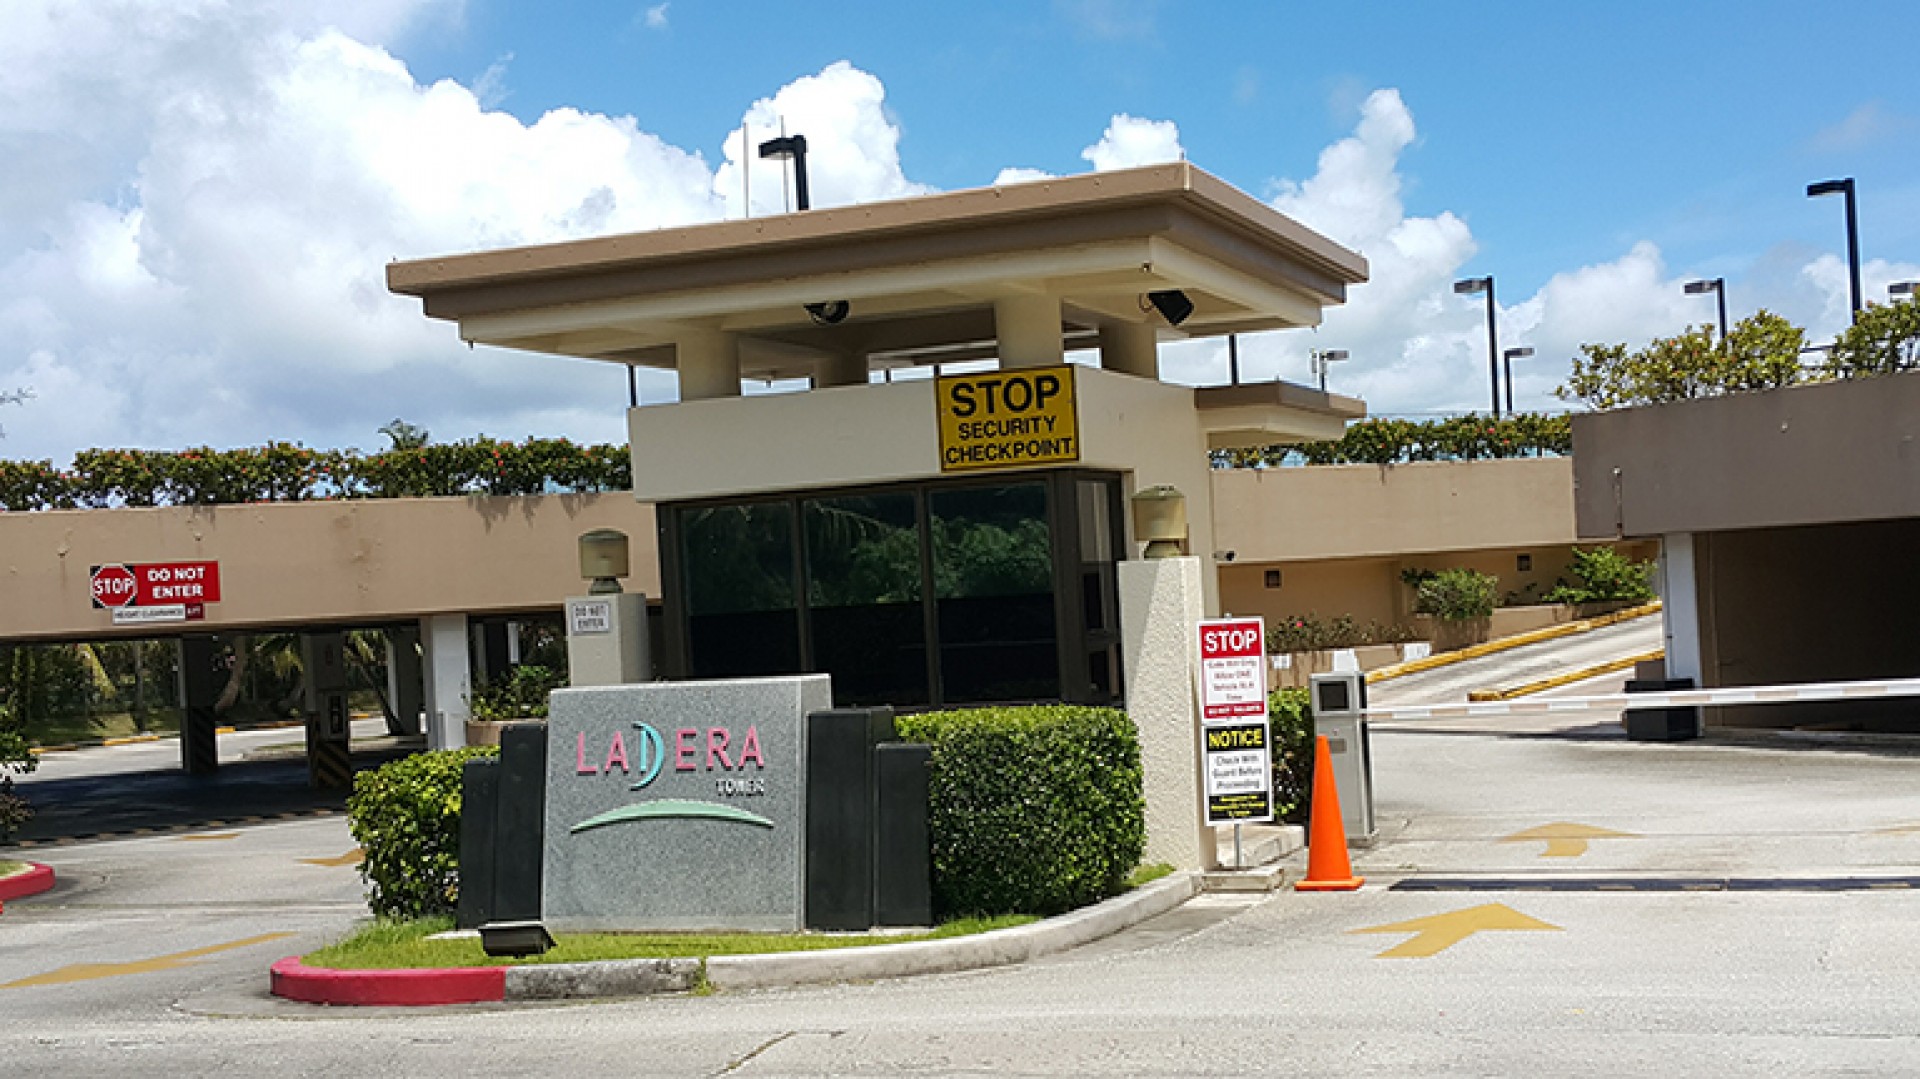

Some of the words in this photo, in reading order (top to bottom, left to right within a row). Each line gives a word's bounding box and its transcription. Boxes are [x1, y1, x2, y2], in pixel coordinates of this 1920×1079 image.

[951, 375, 1060, 417] STOP
[958, 415, 1057, 441] SECURITY
[945, 437, 1072, 464] CHECKPOINT
[147, 567, 171, 582] DO
[174, 566, 205, 581] NOT
[94, 577, 134, 595] STOP
[152, 583, 204, 599] ENTER
[1205, 628, 1258, 653] STOP
[1208, 728, 1263, 749] NOTICE
[576, 721, 764, 790] LADERA
[1214, 755, 1240, 767] Check
